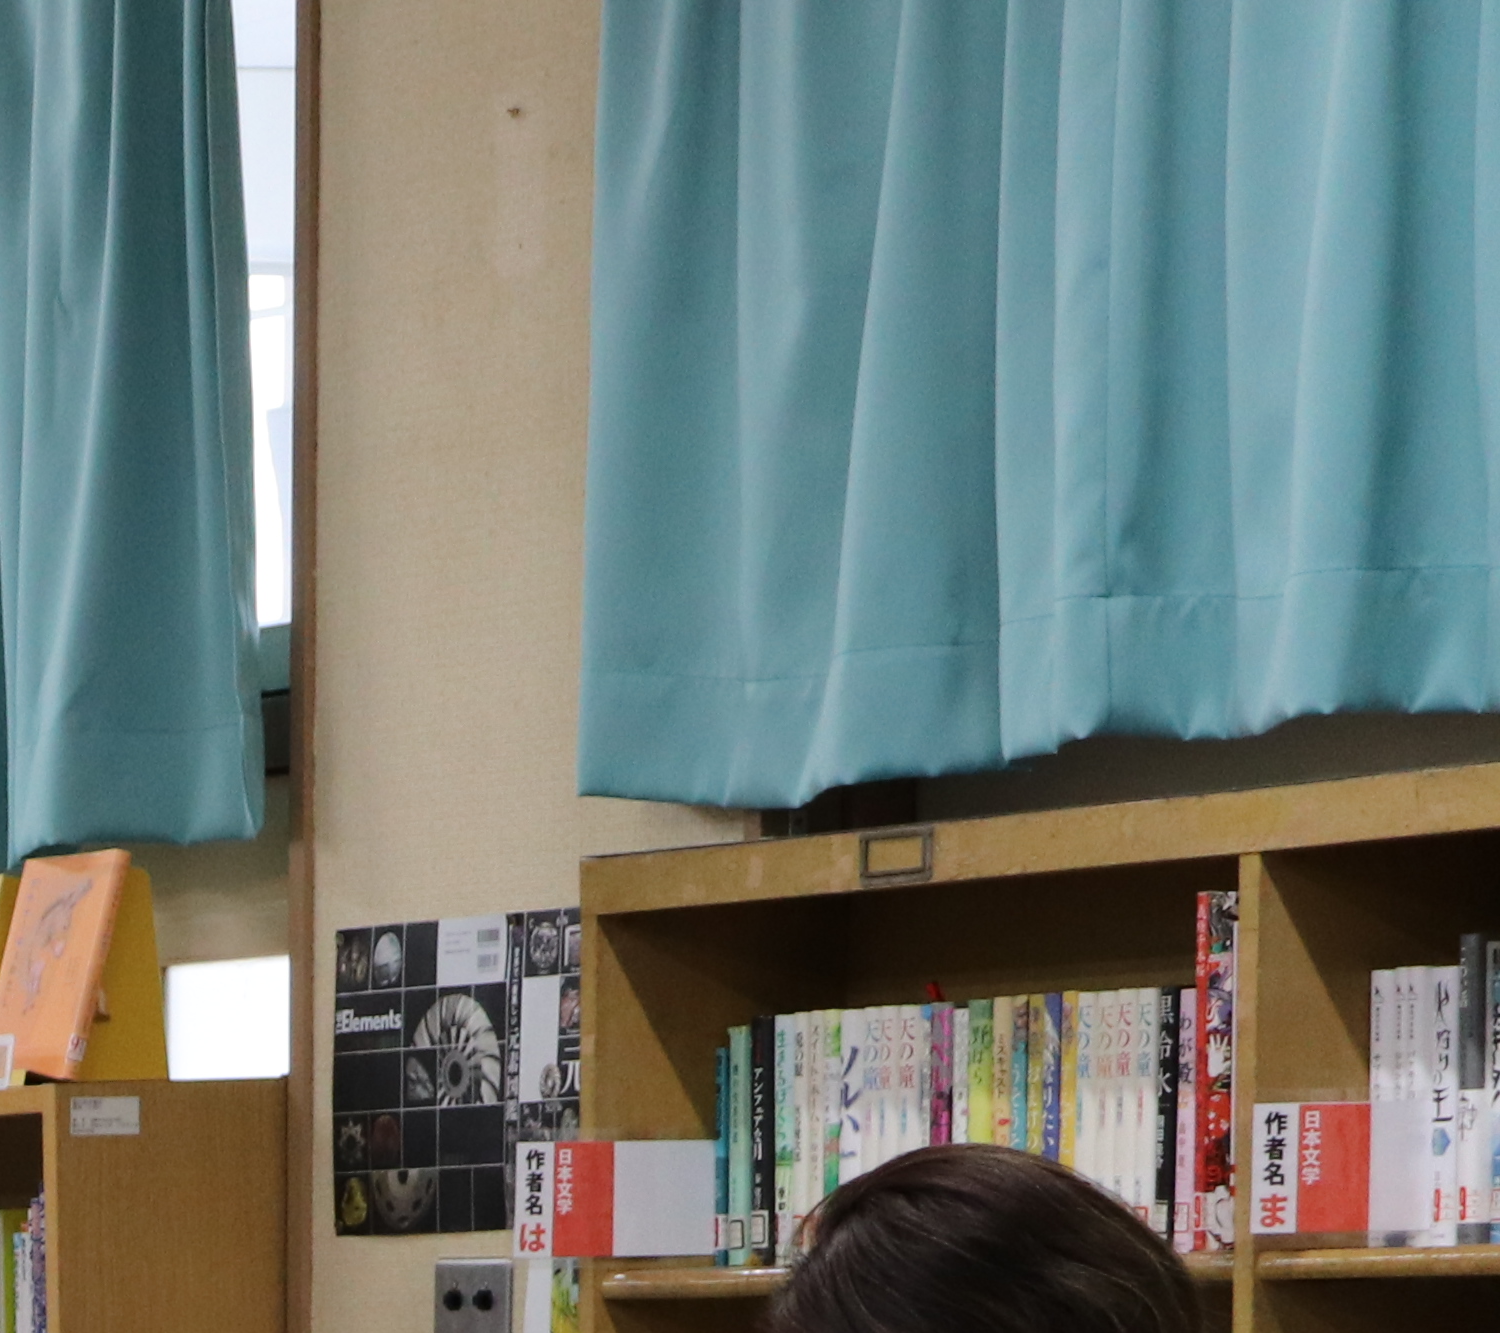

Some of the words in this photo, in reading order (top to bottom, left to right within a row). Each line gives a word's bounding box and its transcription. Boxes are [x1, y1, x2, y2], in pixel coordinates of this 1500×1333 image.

[342, 1008, 402, 1034] Elements
[900, 1017, 916, 1089] 天の瞳
[970, 1023, 988, 1086] 野ばら
[1264, 1112, 1288, 1186] 作者名
[1301, 1110, 1321, 1186] 日本文学
[525, 1150, 545, 1215] 作者名
[557, 1149, 573, 1214] 日本文学
[1259, 1194, 1288, 1227] ま
[520, 1223, 546, 1252] は
